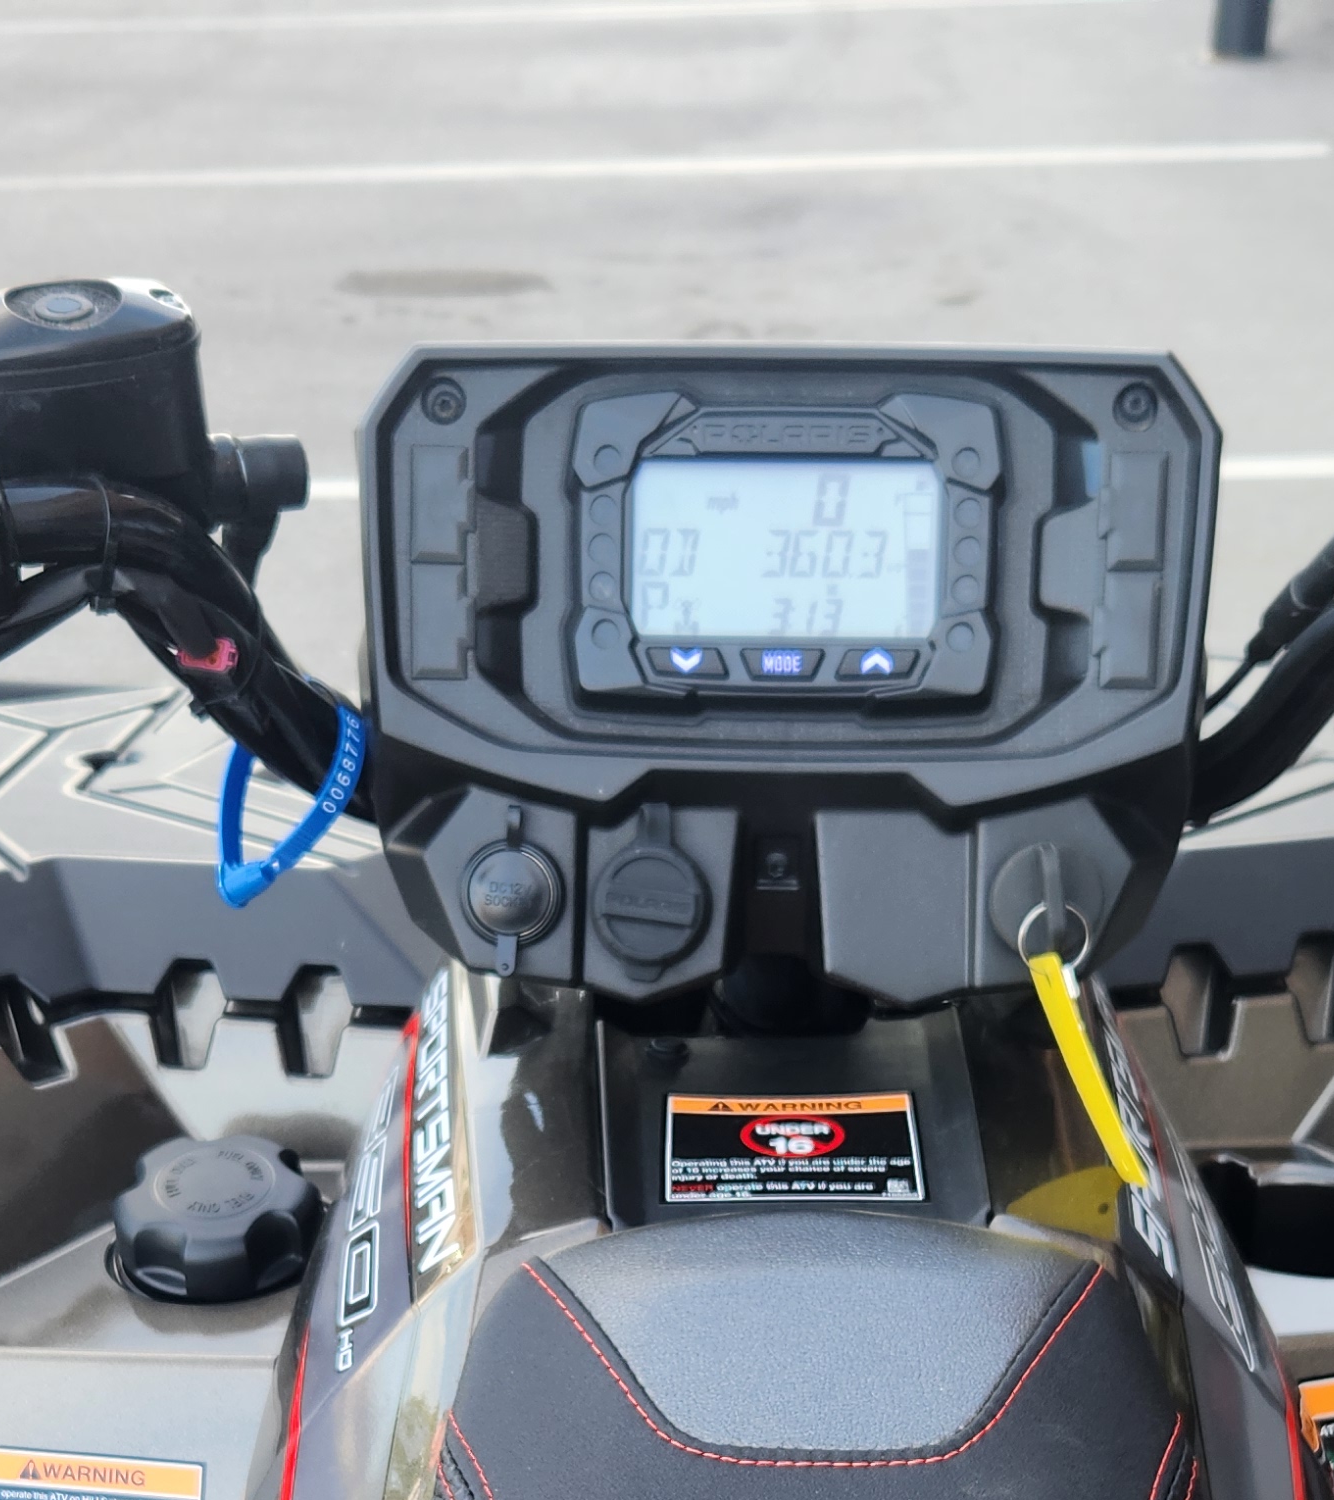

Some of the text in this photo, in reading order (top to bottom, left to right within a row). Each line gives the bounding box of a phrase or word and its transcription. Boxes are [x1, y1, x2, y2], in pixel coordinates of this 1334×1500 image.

[706, 491, 739, 513] mph
[813, 472, 851, 527] 0
[763, 654, 802, 672] MODE
[323, 712, 360, 813] 0068776
[738, 1102, 862, 1112] WARNING
[414, 967, 462, 1275] SPORTSMAN
[755, 1122, 831, 1135] UNDER
[769, 1136, 815, 1155] 16
[671, 1156, 911, 1168] Operating this ATV you are under the age
[760, 1166, 786, 1174] your
[671, 1173, 703, 1182] injury
[672, 1181, 874, 1192] NEVER operate this ATV you are
[671, 1191, 732, 1200] under age
[43, 1462, 145, 1486] WARNING
[1, 1489, 32, 1499] operate
[33, 1490, 48, 1499] this
[50, 1492, 68, 1500] ATV
